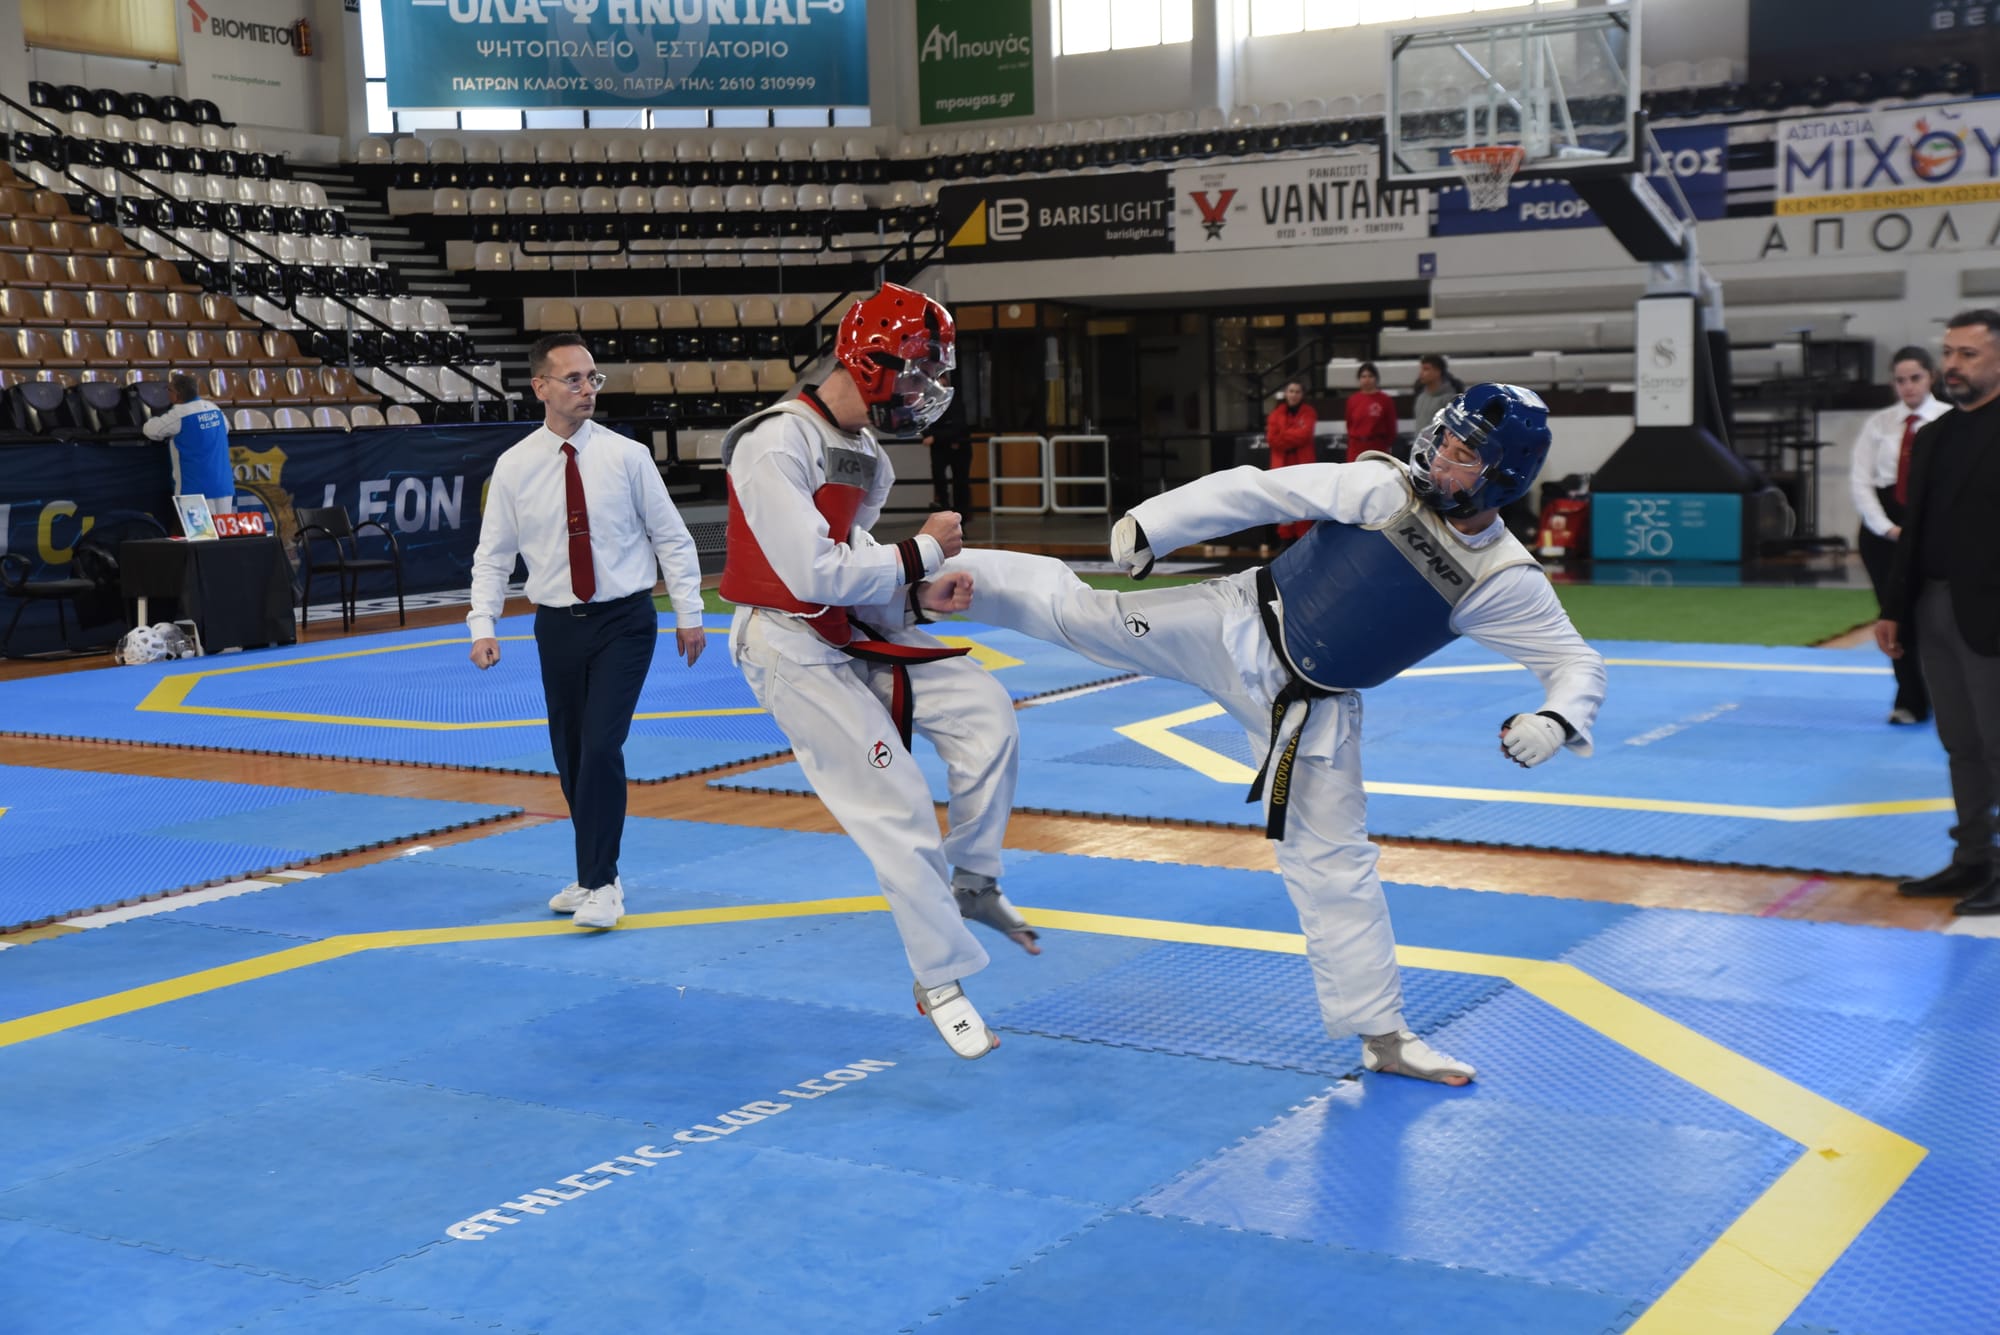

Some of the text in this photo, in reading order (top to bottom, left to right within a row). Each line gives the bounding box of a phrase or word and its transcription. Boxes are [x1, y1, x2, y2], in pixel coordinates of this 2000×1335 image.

[477, 40, 788, 58] ΨΗΤΟΠΩΛΕΙΟ ΕΣΤΙΑΤΟΡΙΟ
[452, 77, 519, 91] ΠΑΤΡΩΝ
[524, 77, 589, 91] ΚΛΑΟΥΣ
[623, 77, 675, 91] ΠΑΤΡΑ
[680, 77, 714, 91] ΤΗΛ:
[719, 76, 756, 91] 2610
[760, 76, 816, 91] 310999
[936, 92, 1015, 113] mpougas.gr
[1039, 199, 1166, 228] BARISLIGHT
[1105, 226, 1166, 241] barislight.eu
[1398, 525, 1464, 587] KPNP
[446, 1059, 897, 1240] ATHLETIC CLUB LEON
